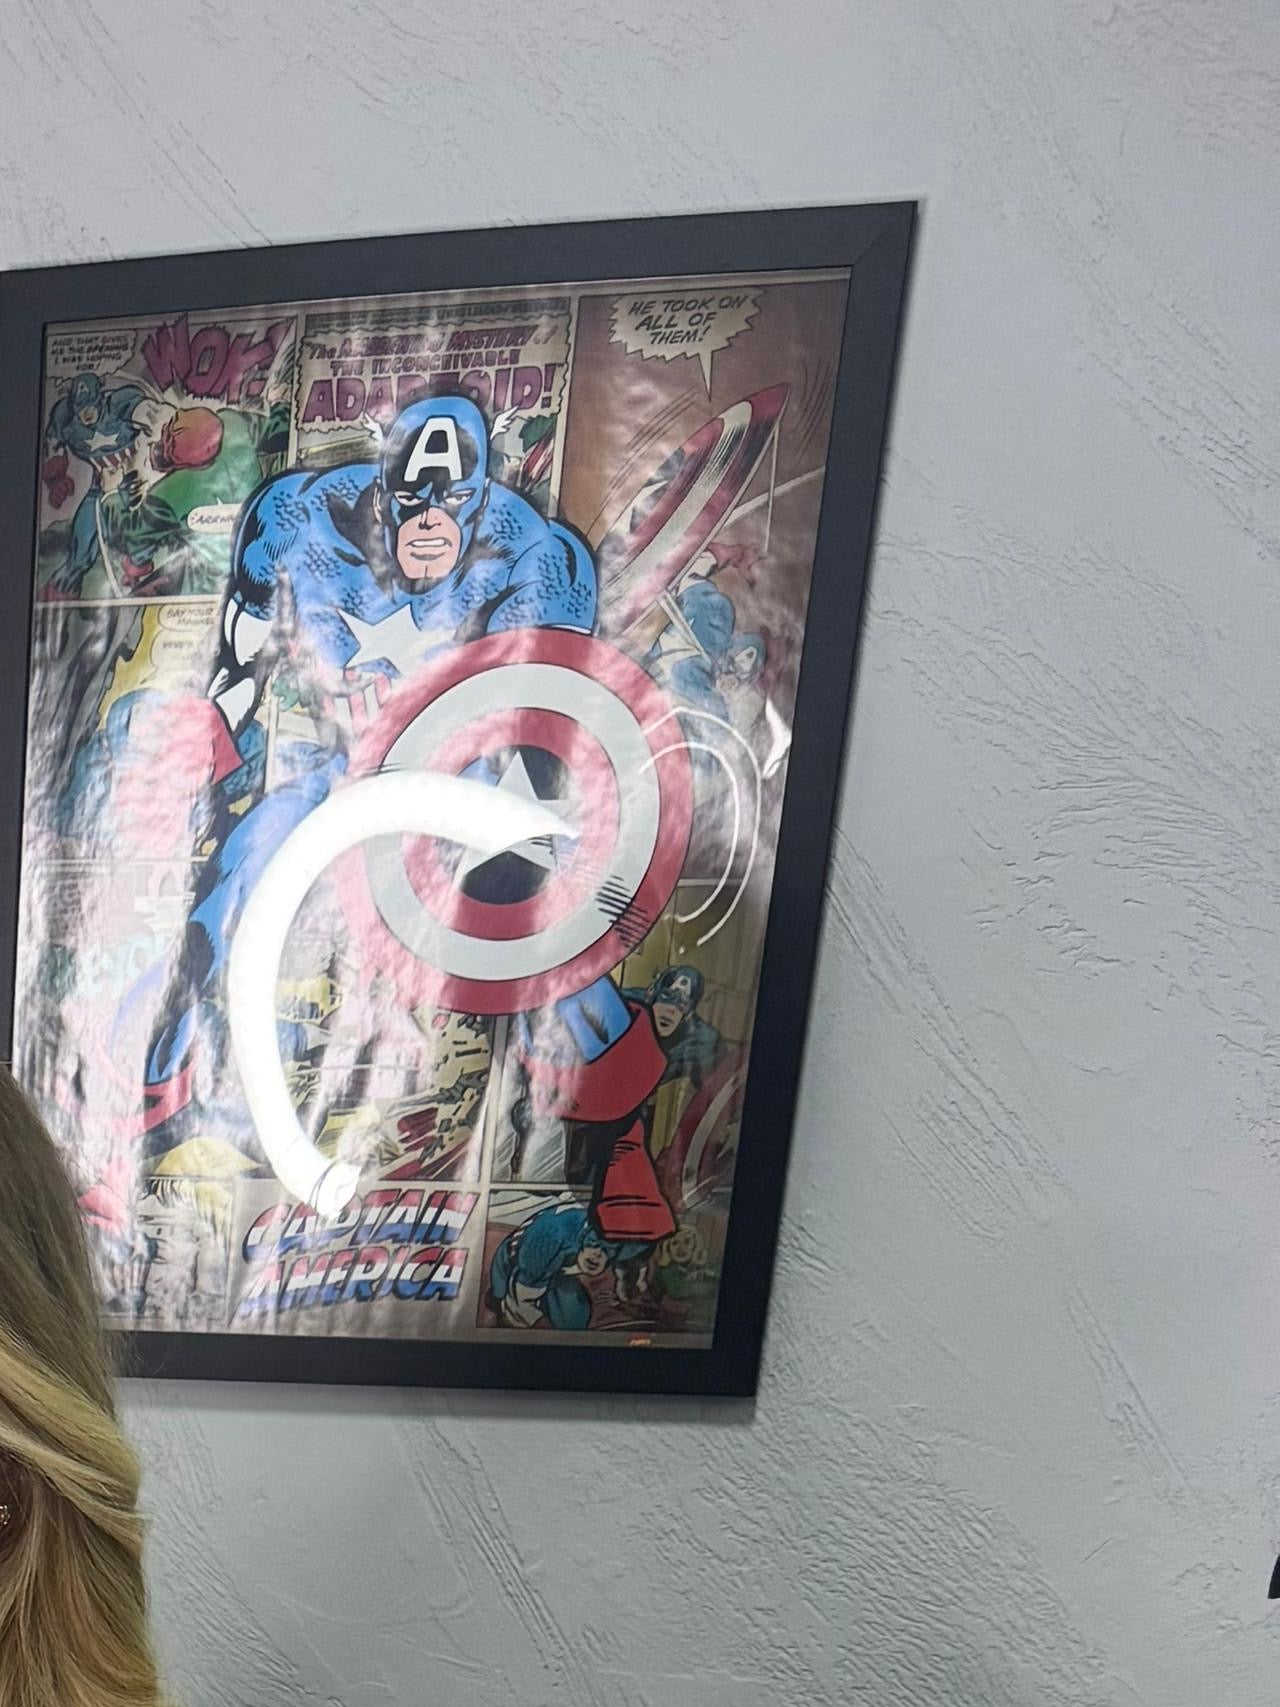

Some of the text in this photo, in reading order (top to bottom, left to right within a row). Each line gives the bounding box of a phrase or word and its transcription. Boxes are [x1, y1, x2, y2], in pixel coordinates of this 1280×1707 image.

[628, 295, 748, 315] HE TOOK ON
[635, 312, 717, 331] ALL OF
[650, 325, 711, 345] THEM!
[237, 1246, 470, 1316] AMERICA
